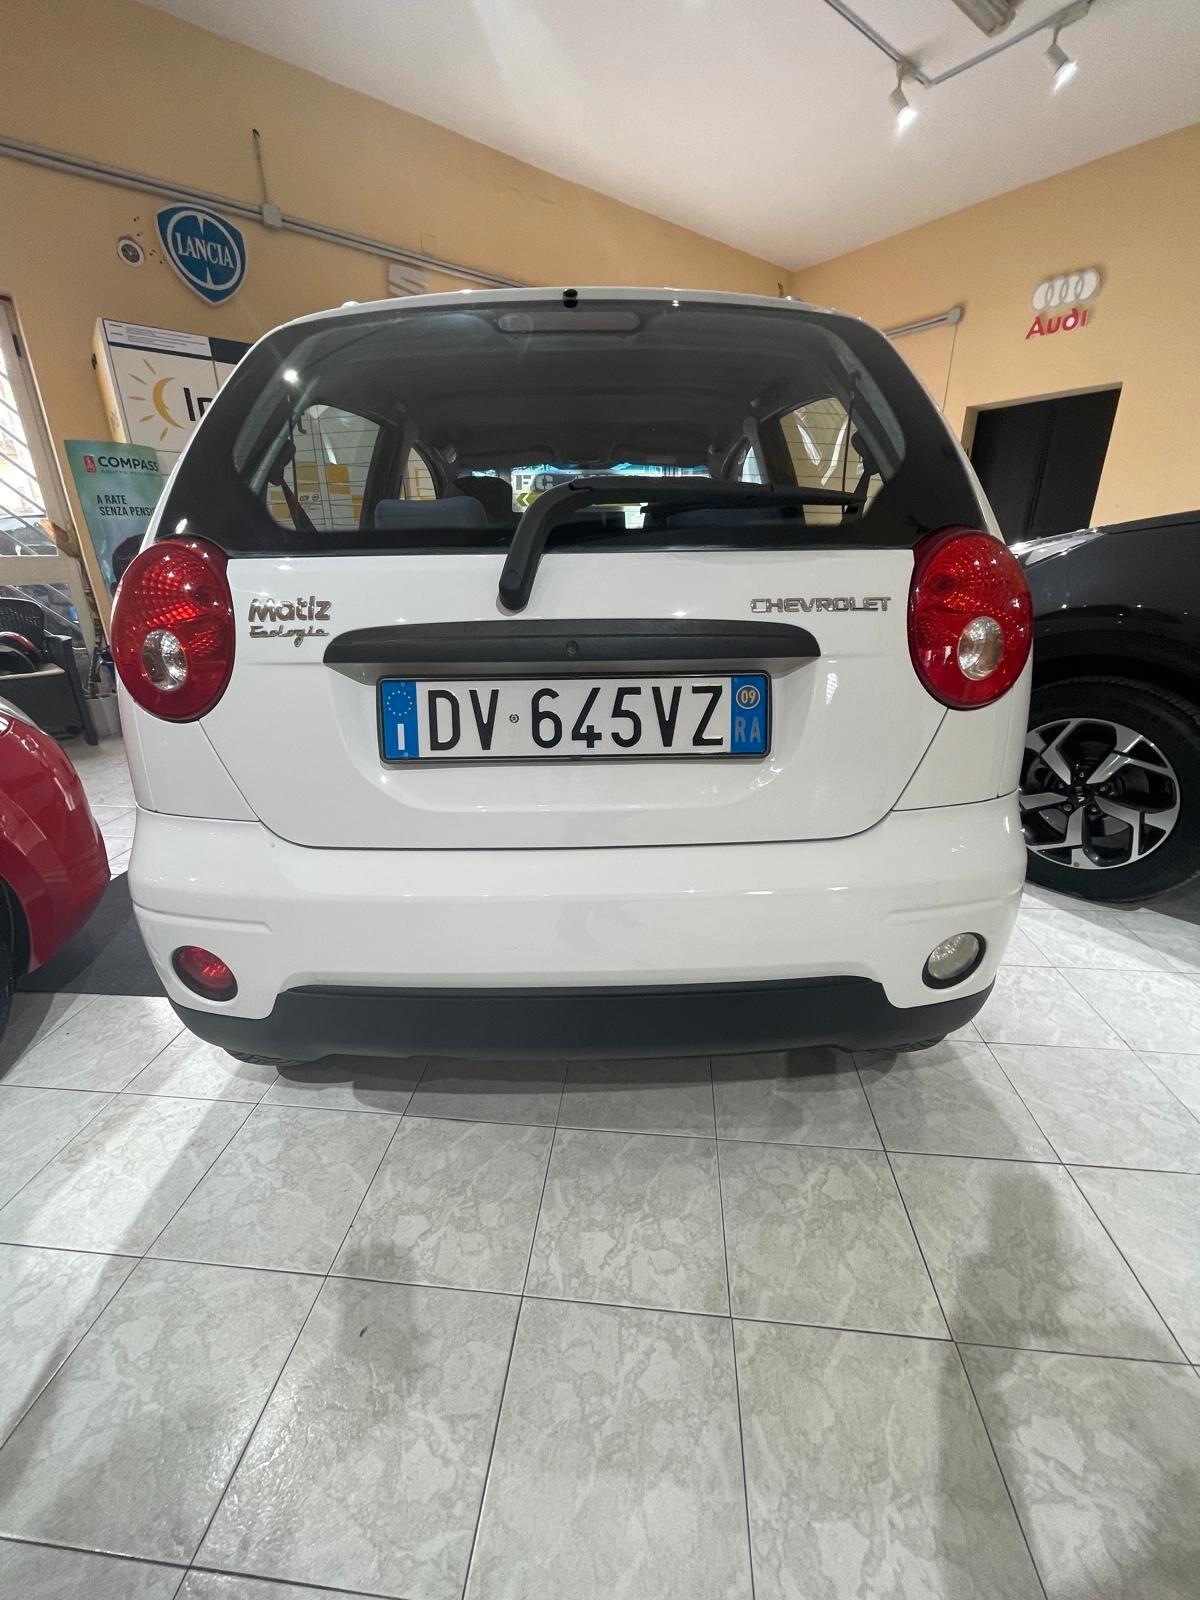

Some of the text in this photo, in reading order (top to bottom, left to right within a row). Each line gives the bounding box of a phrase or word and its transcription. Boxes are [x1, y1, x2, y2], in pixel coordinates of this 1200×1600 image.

[174, 232, 235, 269] LANCIA
[1025, 308, 1088, 340] Audi
[97, 456, 159, 472] COMPASS
[96, 495, 127, 505] A RATE
[100, 506, 128, 516] SENZA
[248, 595, 332, 622] Matiz
[750, 596, 892, 613] CHEVROLET
[740, 689, 756, 704] 09
[397, 685, 724, 751] I DV 645VZ
[734, 715, 762, 743] RA
